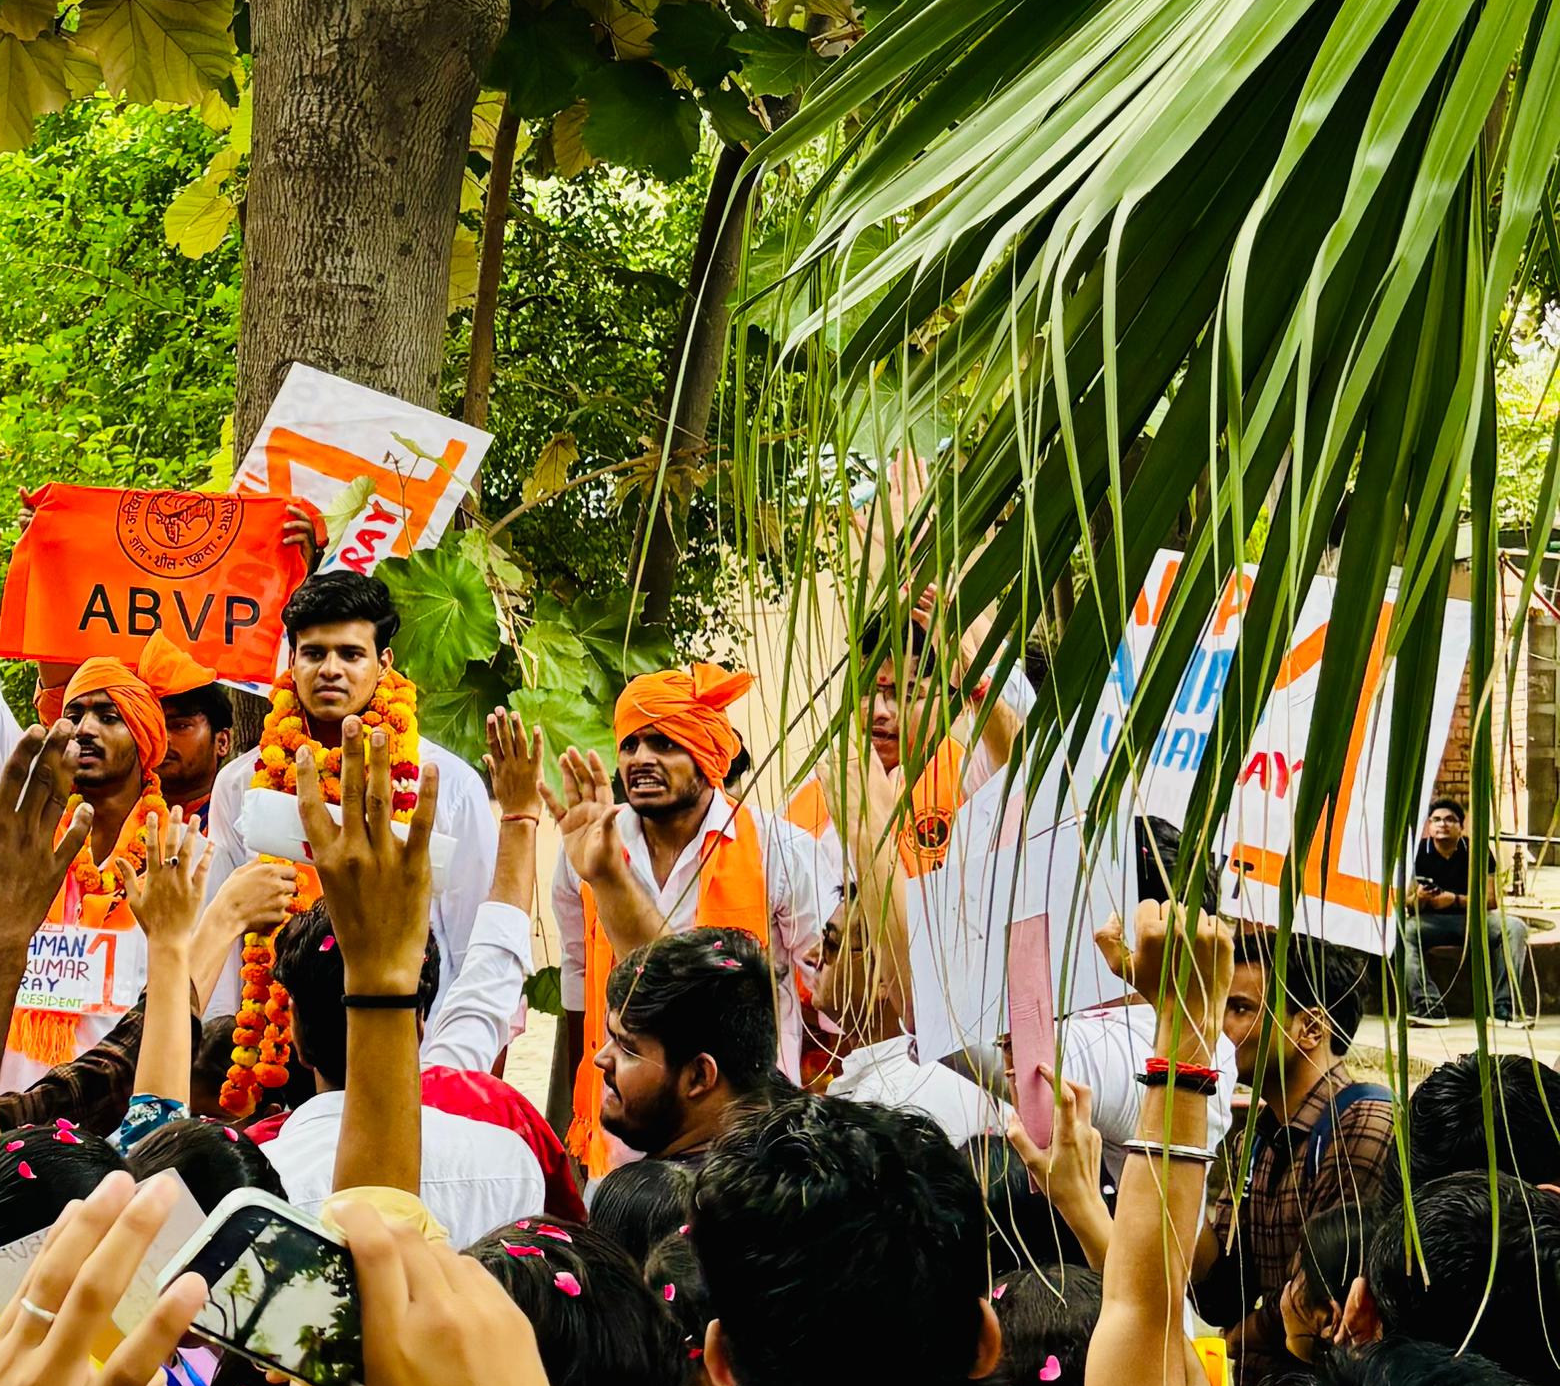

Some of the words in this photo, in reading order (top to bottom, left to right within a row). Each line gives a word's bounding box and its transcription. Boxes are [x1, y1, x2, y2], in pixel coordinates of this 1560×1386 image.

[340, 500, 397, 575] RAY
[78, 584, 261, 646] ABVP
[1237, 751, 1304, 800] AY
[28, 933, 88, 958] AMAN
[20, 976, 60, 993] RAY
[20, 992, 85, 1008] RESIDENT
